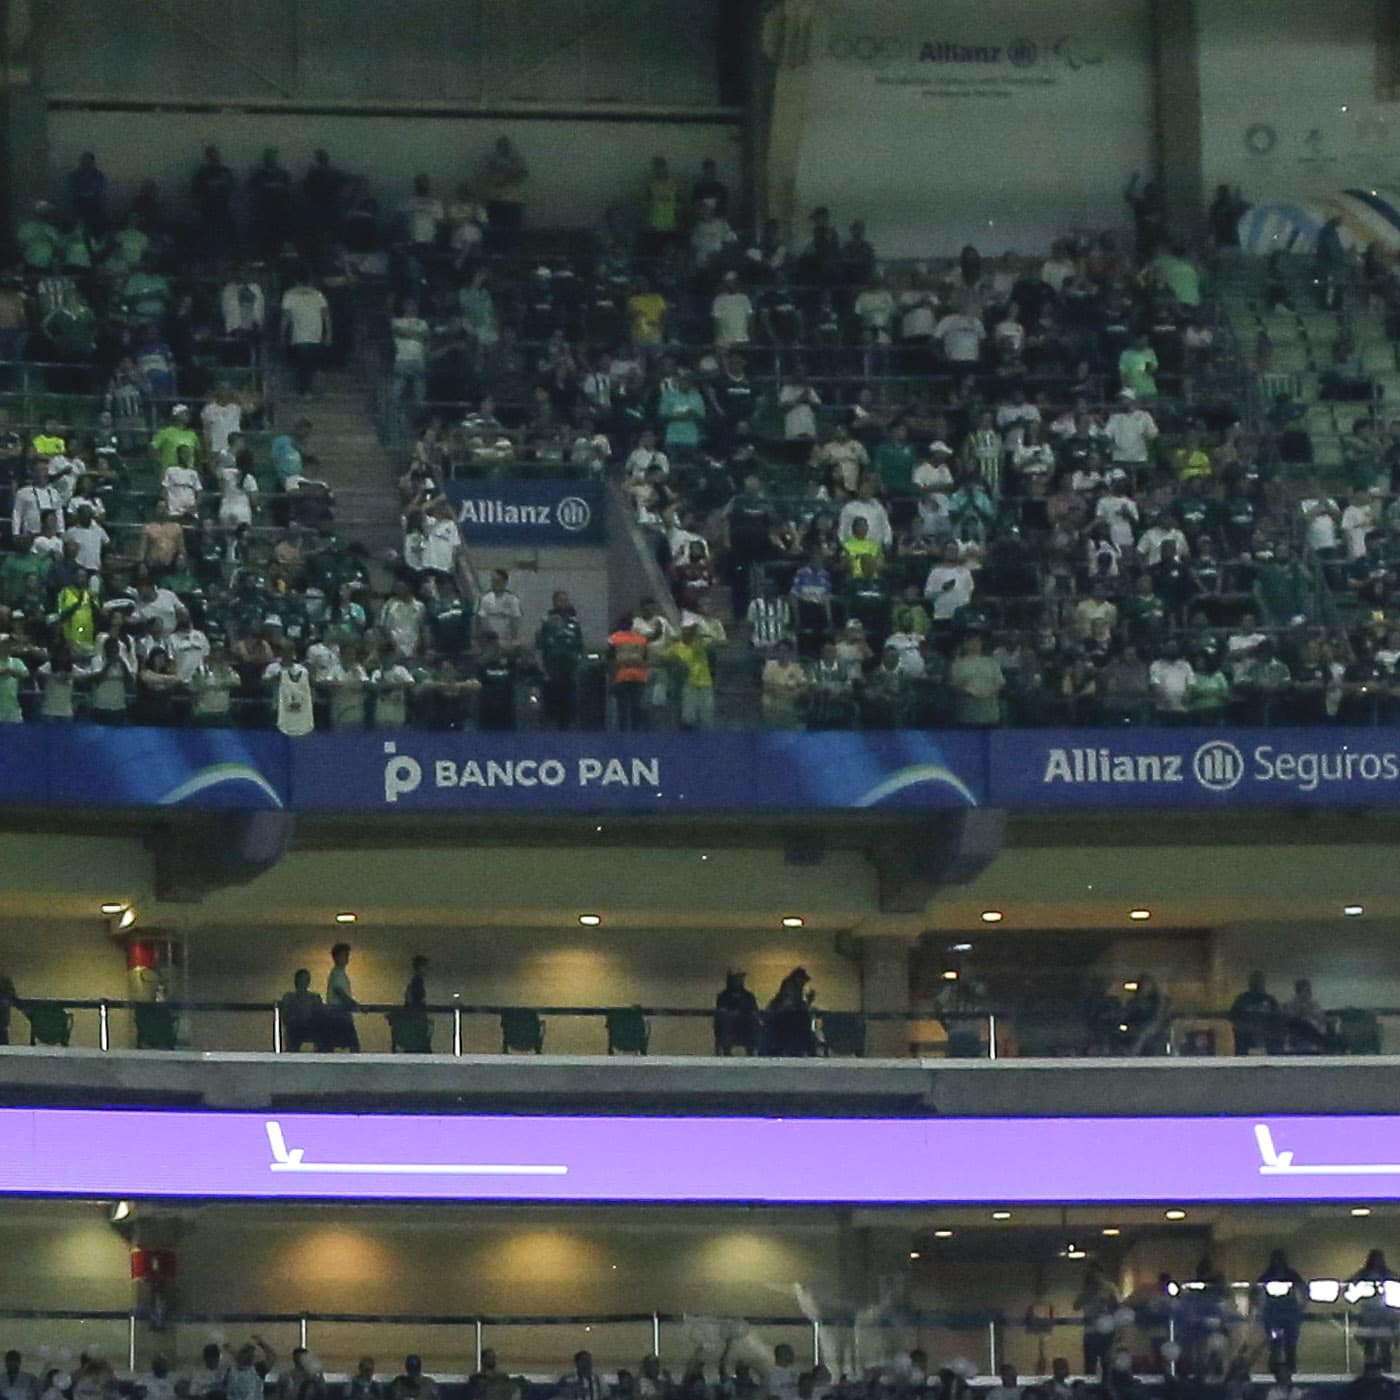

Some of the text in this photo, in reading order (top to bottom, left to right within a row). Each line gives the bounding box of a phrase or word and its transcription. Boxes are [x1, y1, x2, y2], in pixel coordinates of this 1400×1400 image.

[459, 499, 552, 524] Allianz
[435, 757, 661, 789] BANCO PAN
[1043, 745, 1398, 790] Allianz Seguros
